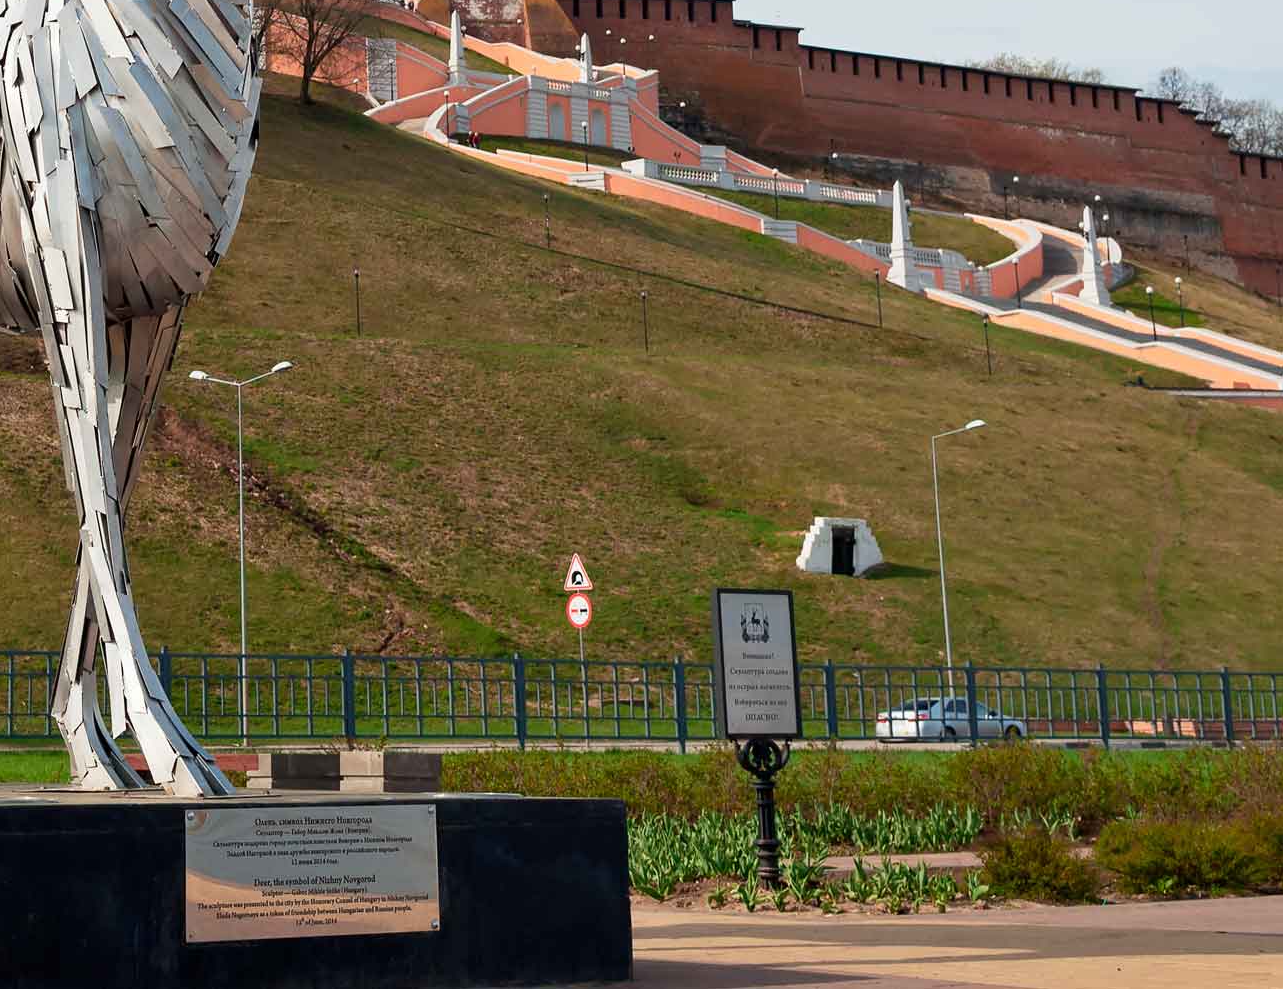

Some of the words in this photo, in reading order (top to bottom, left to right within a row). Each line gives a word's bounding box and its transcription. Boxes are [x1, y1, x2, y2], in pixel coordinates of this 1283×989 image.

[255, 818, 278, 826] Олень,
[304, 817, 335, 825] Нижнего
[336, 816, 373, 826] Новгорода
[254, 878, 273, 887] Deer,
[273, 878, 285, 886] the
[286, 877, 310, 887] symbol
[310, 876, 318, 884] of
[318, 876, 343, 886] Nizhny
[343, 874, 376, 885] Novgorod
